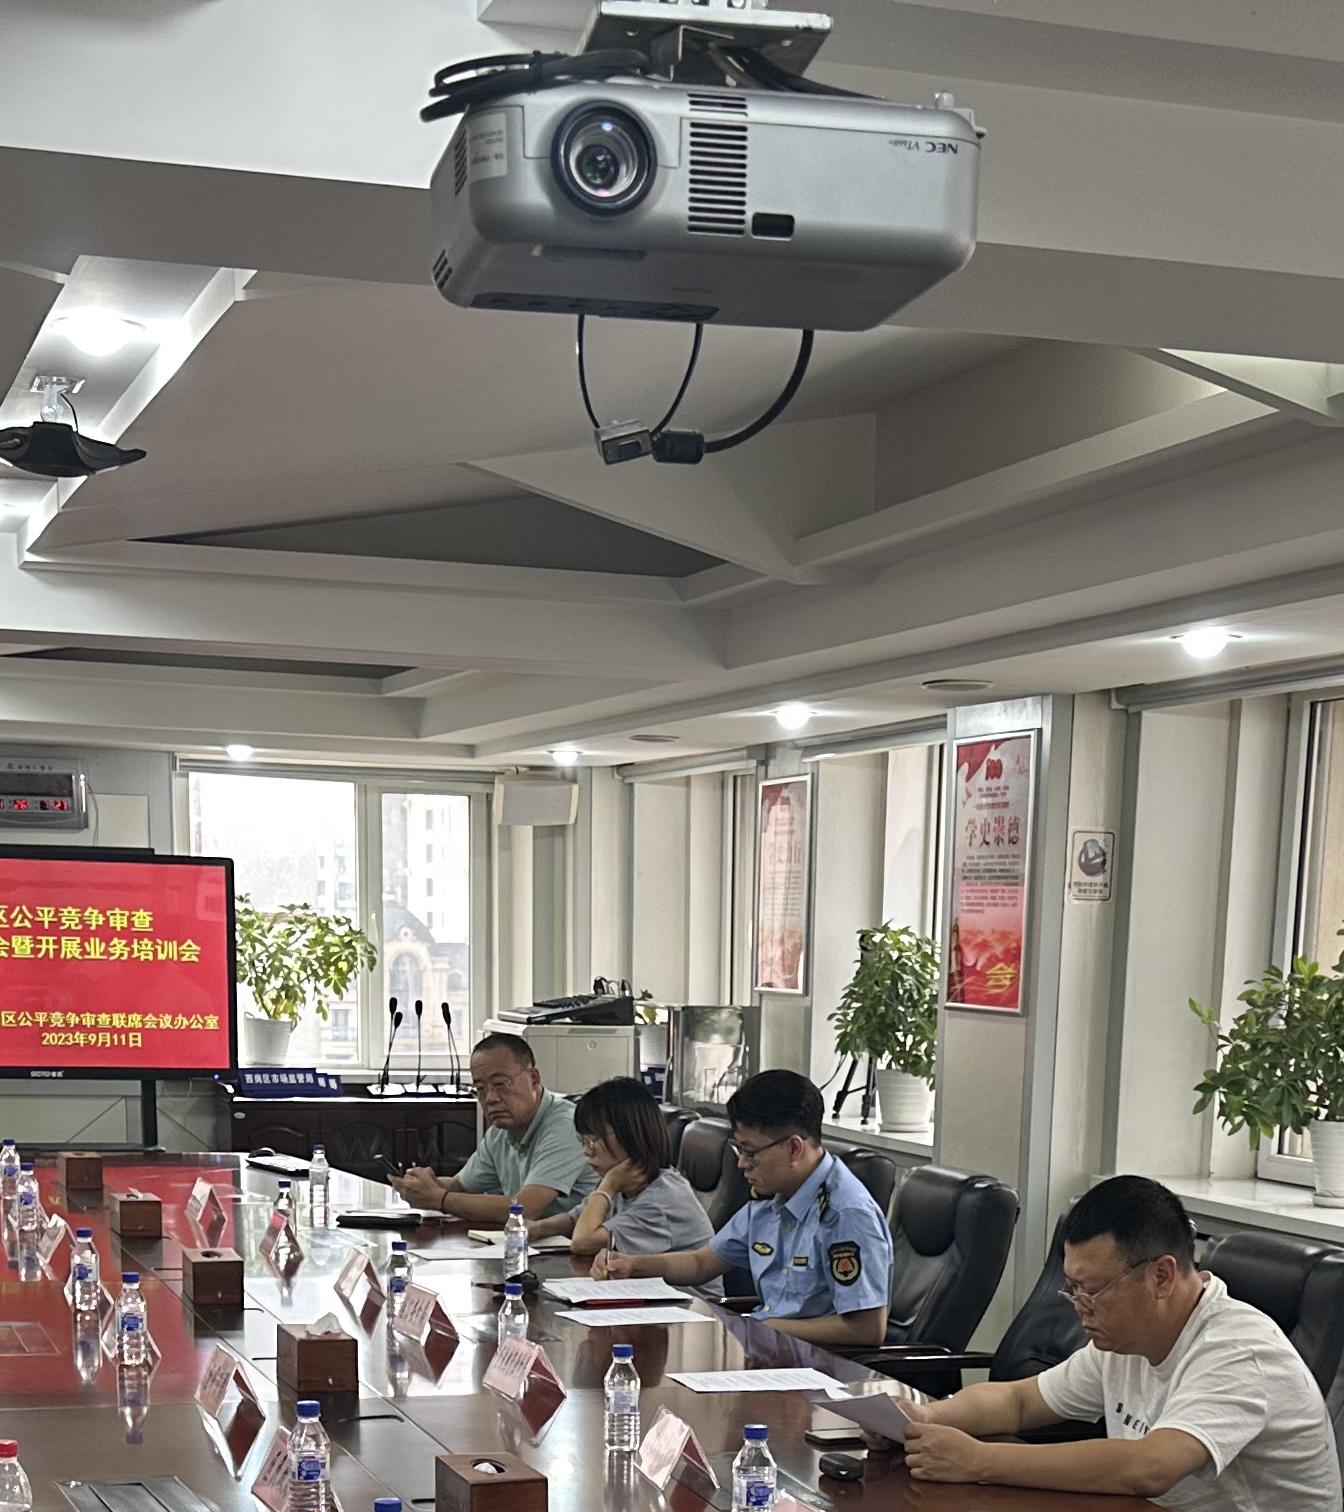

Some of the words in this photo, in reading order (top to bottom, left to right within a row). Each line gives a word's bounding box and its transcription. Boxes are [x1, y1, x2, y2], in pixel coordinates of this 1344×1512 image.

[924, 141, 959, 155] NEC
[41, 1031, 143, 1048] 2023年9月11日
